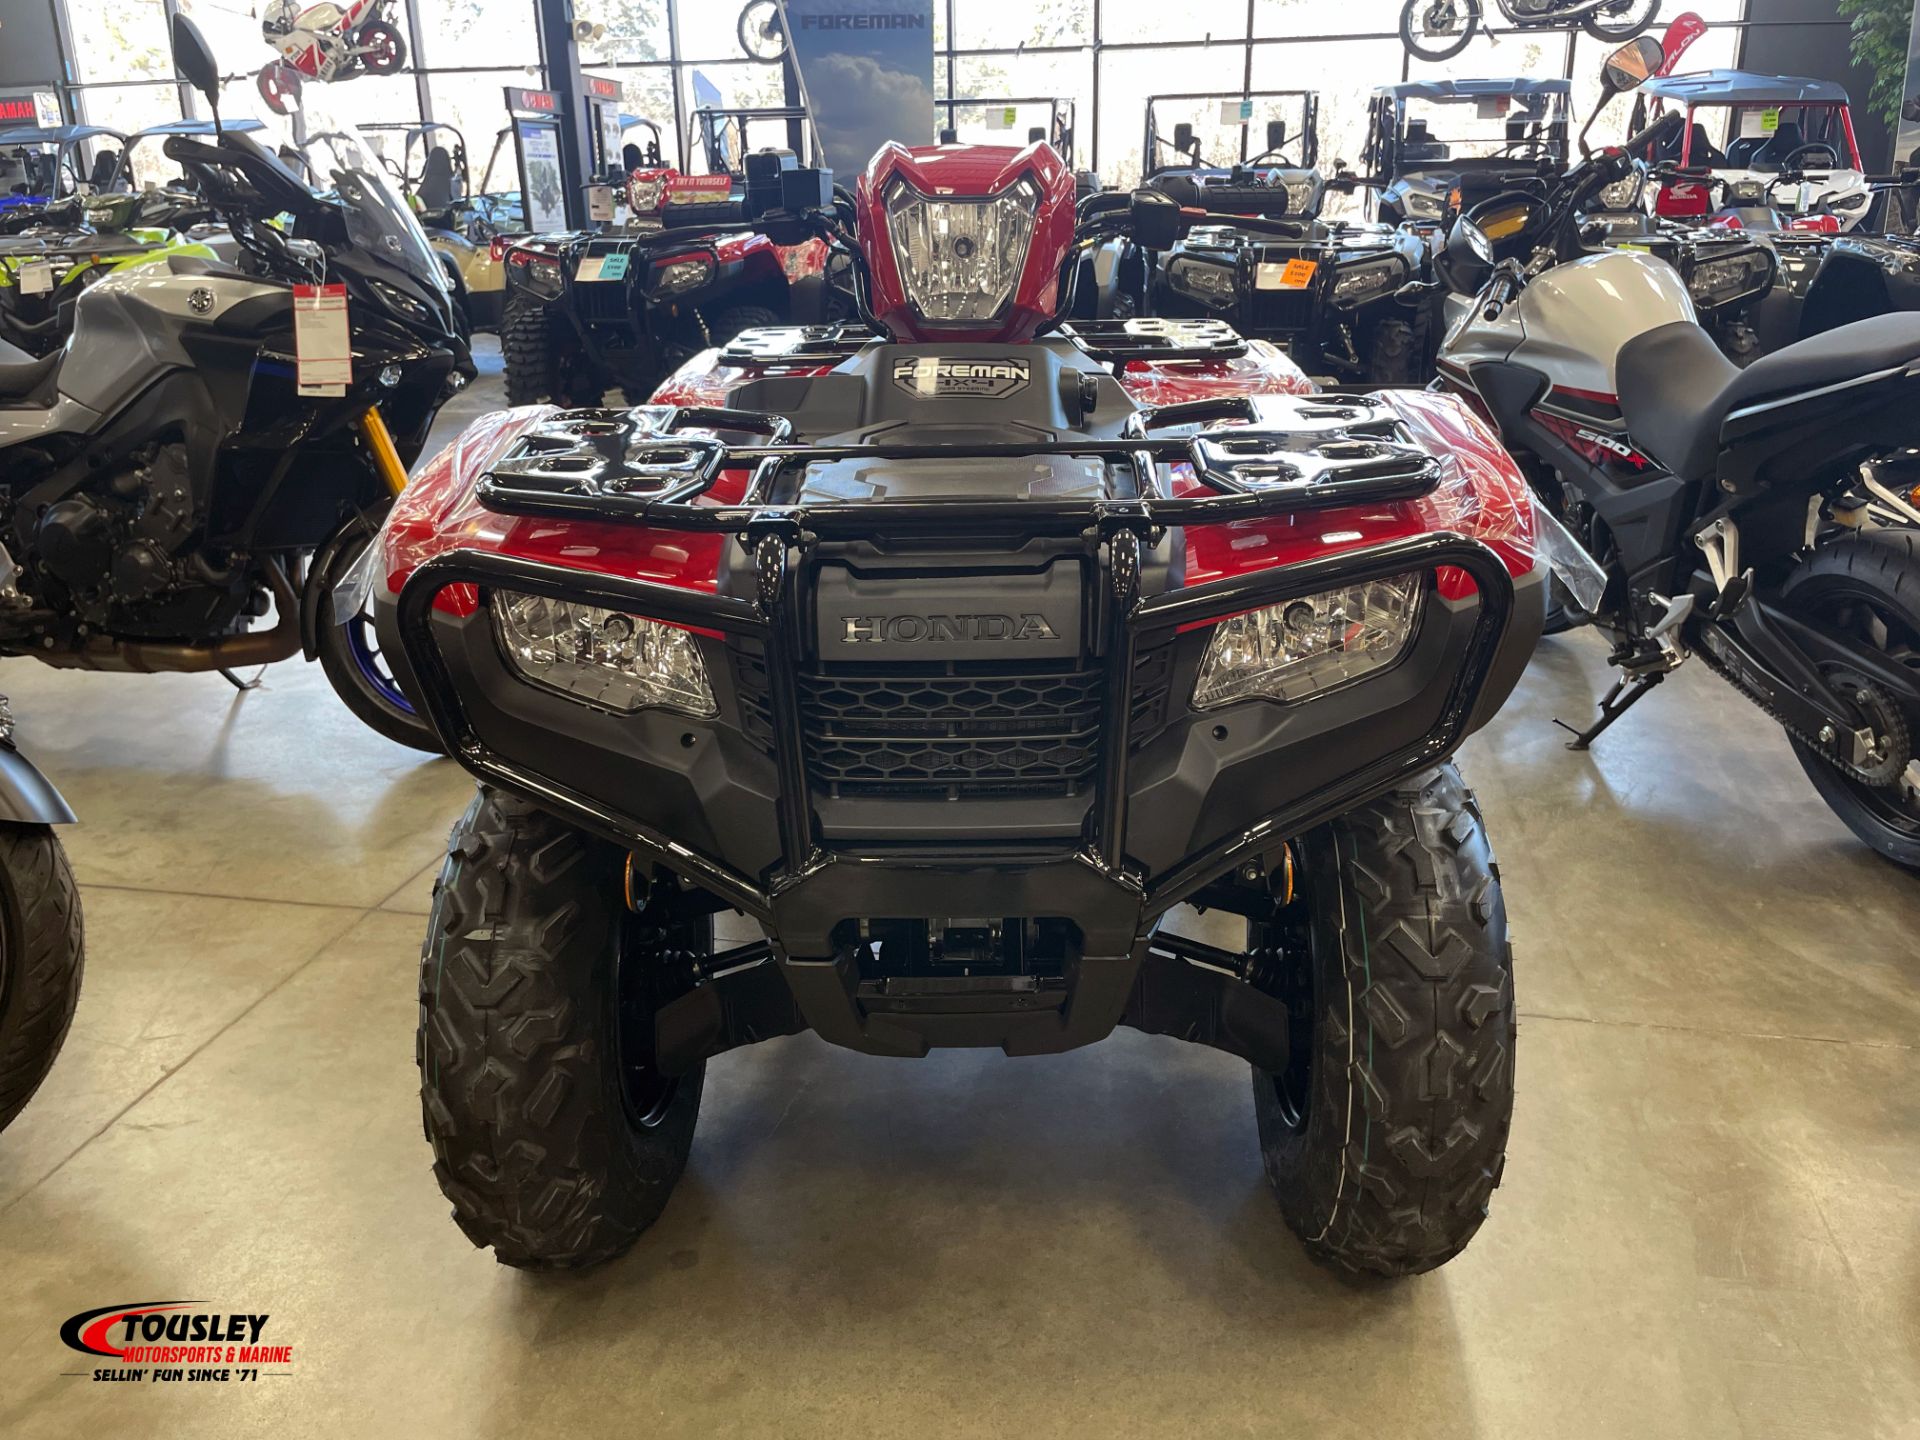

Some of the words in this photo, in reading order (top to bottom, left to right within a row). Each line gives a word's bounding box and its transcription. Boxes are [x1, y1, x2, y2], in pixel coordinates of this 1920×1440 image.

[801, 14, 925, 29] FOREMAN
[1660, 28, 1700, 75] TALON
[676, 178, 688, 186] TRY
[696, 177, 727, 186] YOURSELF
[894, 365, 1030, 380] FOREMAN
[840, 614, 1061, 642] HONDA
